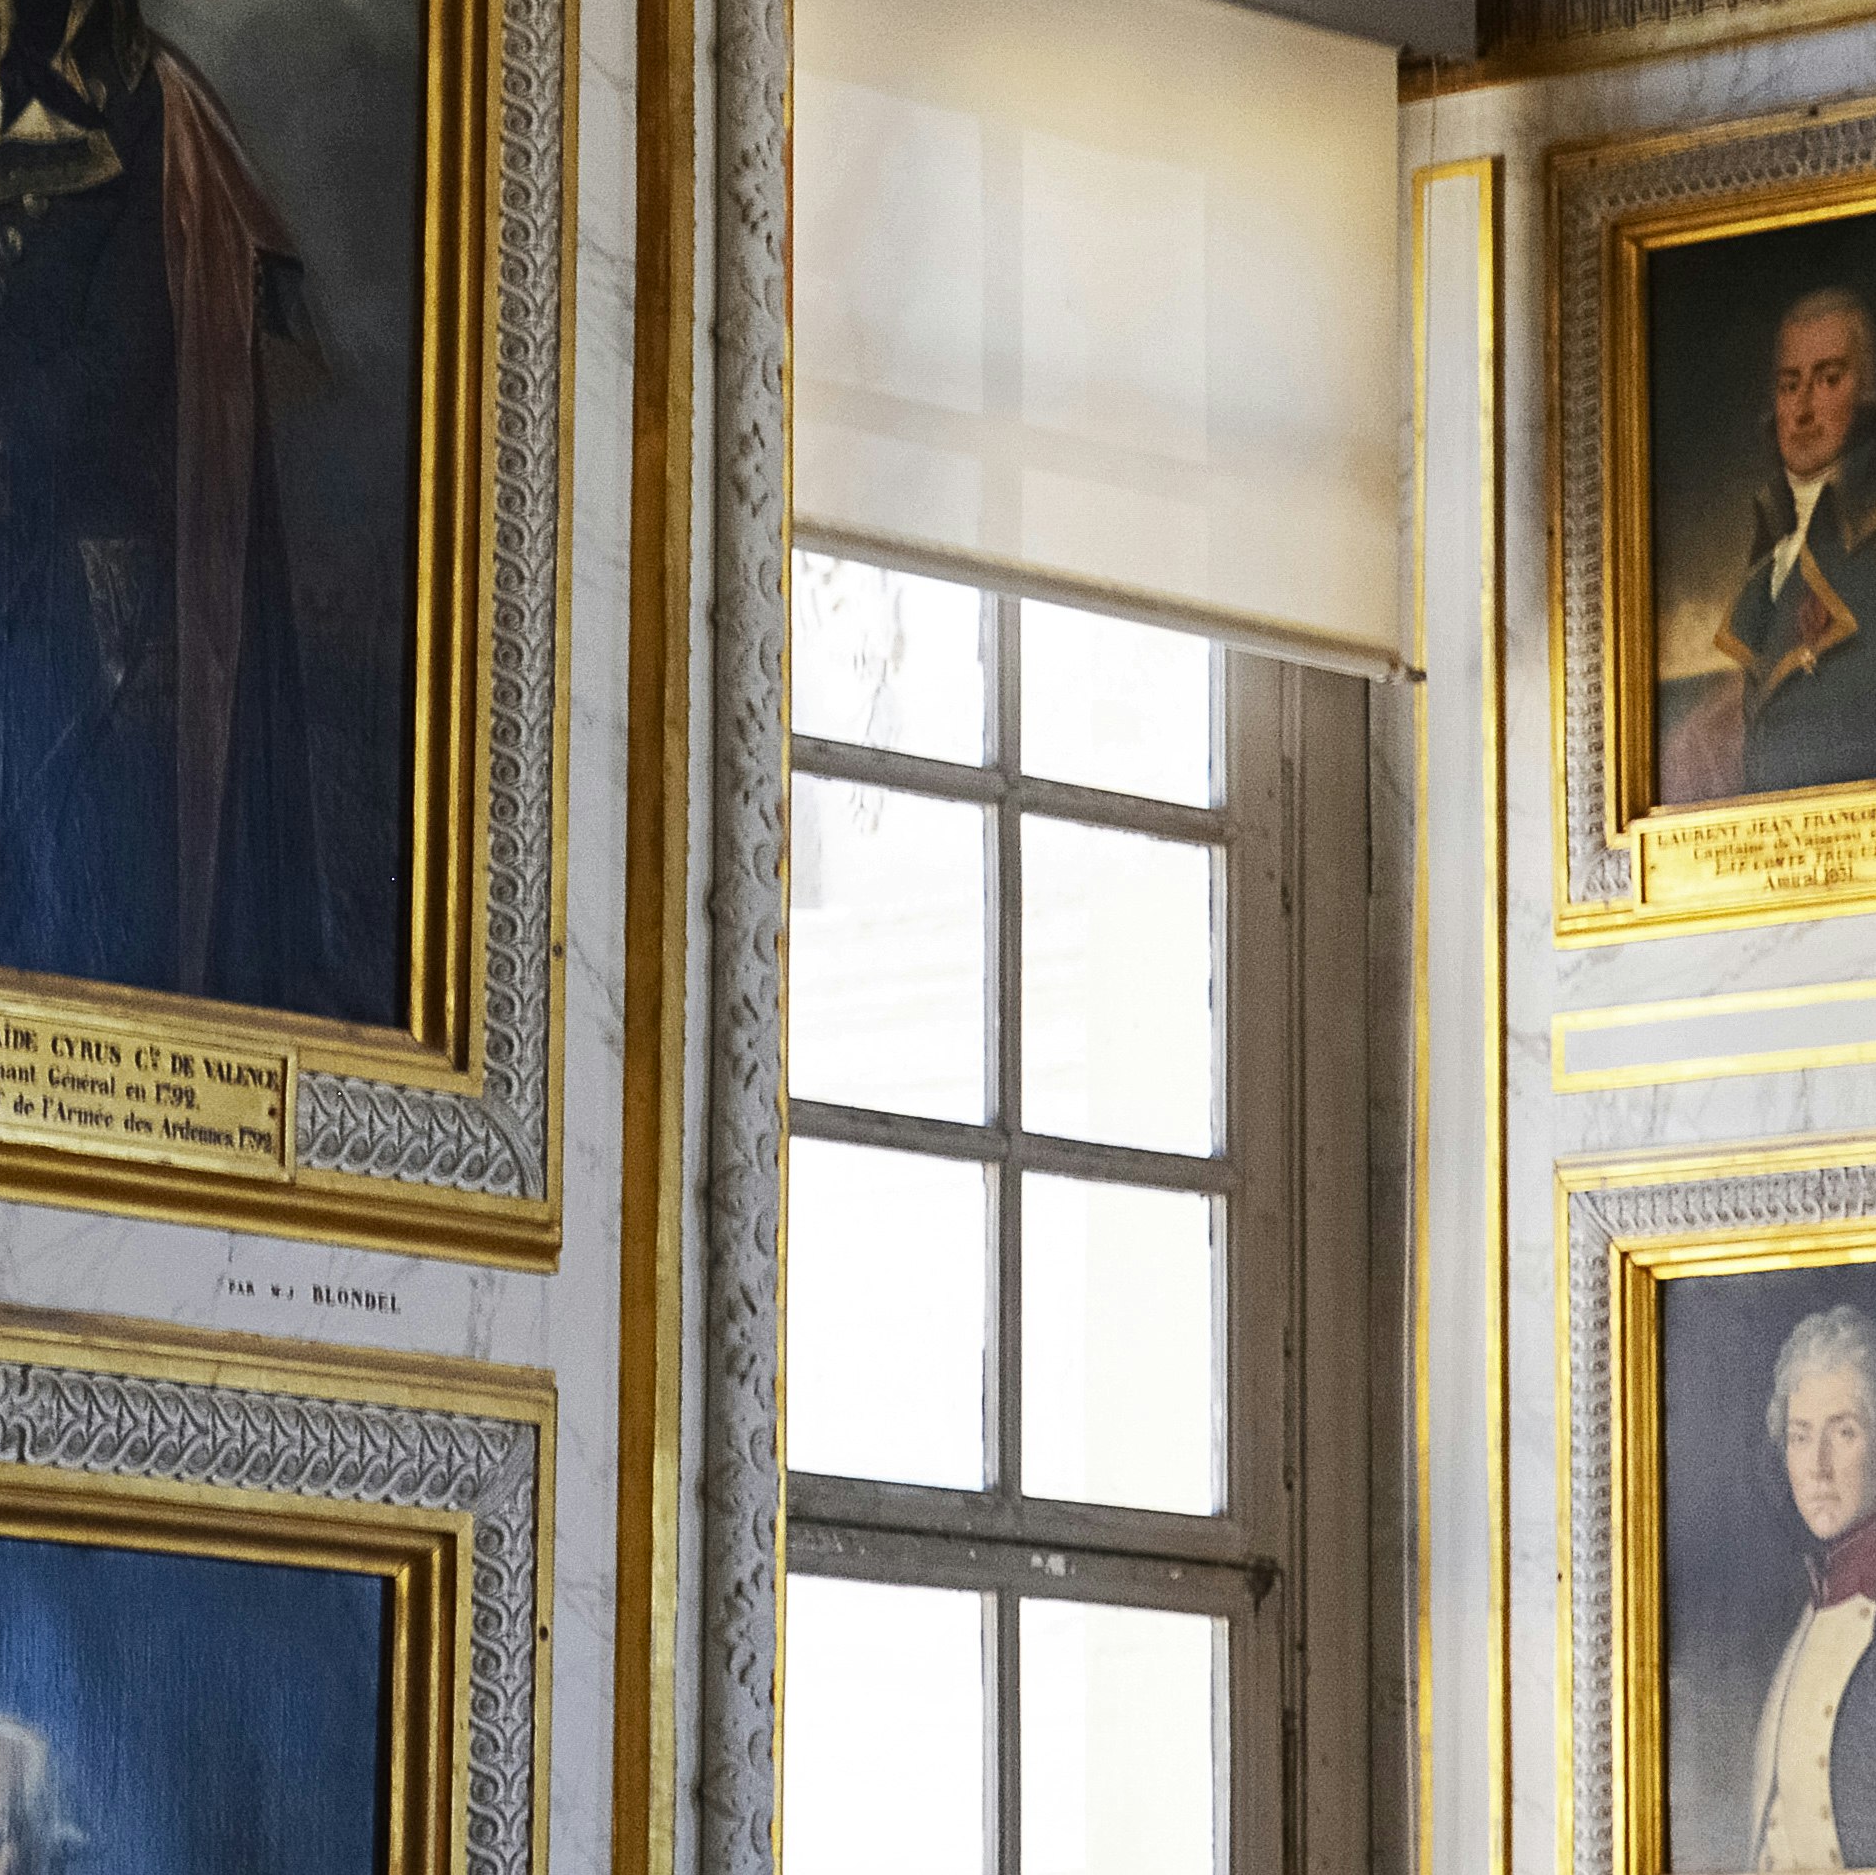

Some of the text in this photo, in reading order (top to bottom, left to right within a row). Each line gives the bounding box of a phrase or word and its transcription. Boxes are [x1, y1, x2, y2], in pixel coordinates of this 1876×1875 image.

[1747, 818, 1793, 836] JEAN
[51, 1034, 122, 1067] CYRUS
[171, 1052, 195, 1079] DE
[48, 1065, 116, 1097] Général
[125, 1083, 147, 1102] en
[13, 1092, 35, 1116] de
[123, 1109, 154, 1134] des
[228, 1278, 255, 1297] PAR
[312, 1284, 402, 1315] BLONDEL
